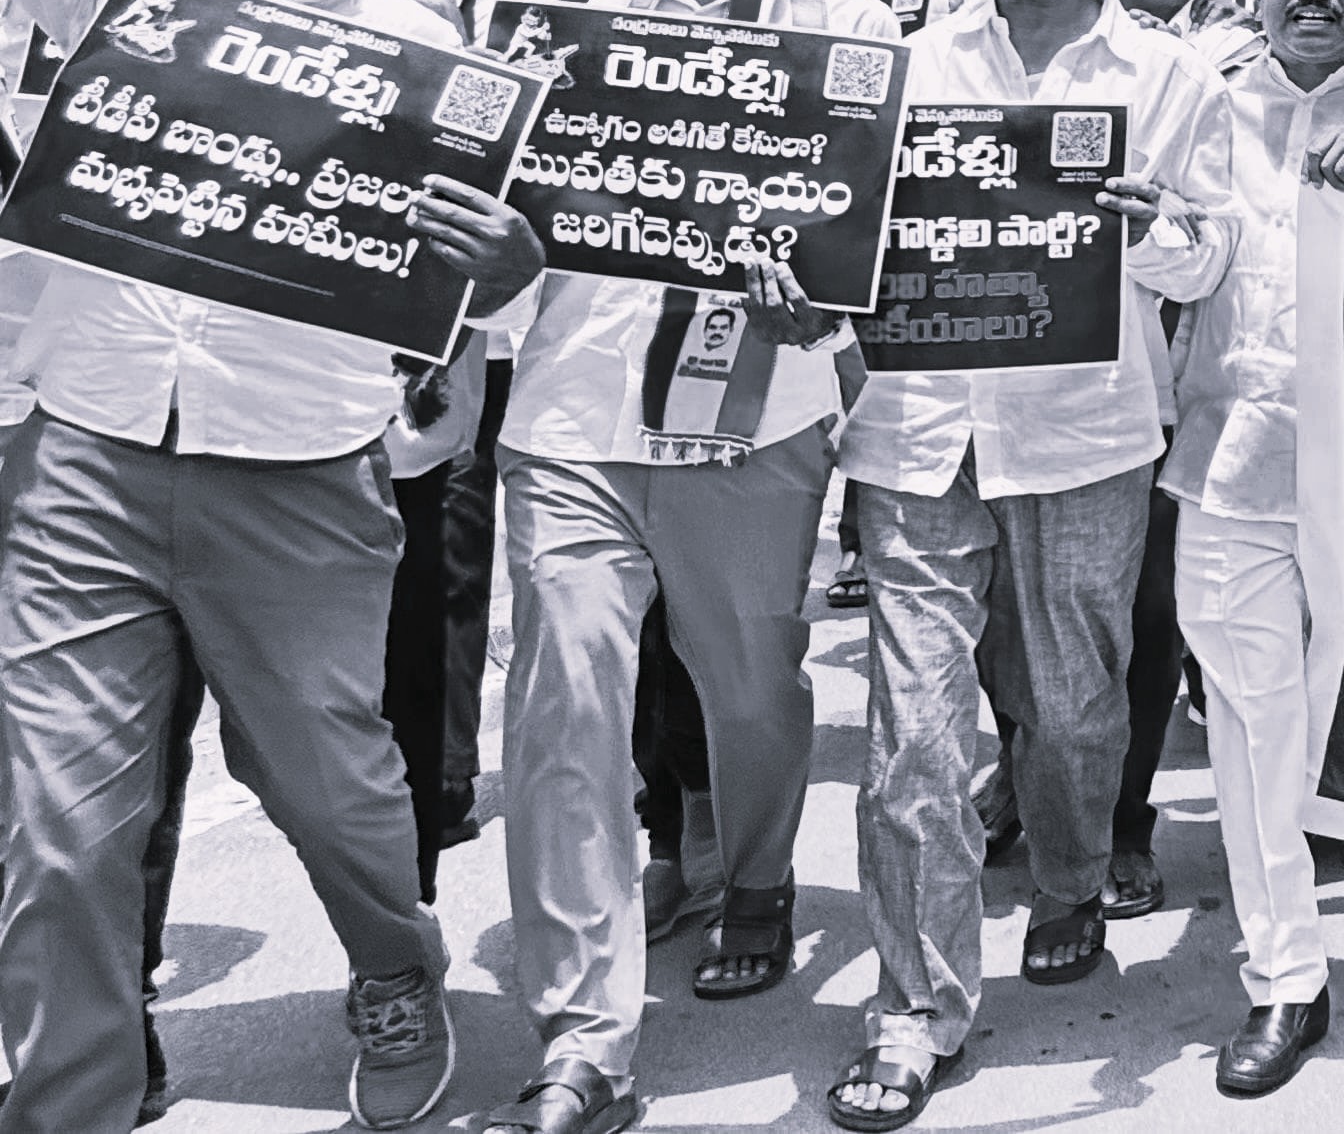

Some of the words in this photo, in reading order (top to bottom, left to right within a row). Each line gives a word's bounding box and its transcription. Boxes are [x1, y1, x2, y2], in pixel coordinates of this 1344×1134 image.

[237, 0, 313, 31] చంద్రబాబు
[312, 20, 402, 56] వెన్నుపోటుకు
[612, 16, 688, 39] చంద్రబాబు
[690, 26, 780, 47] వెన్నుపోటుకు
[207, 25, 400, 132] రెండేళ్లు
[604, 43, 790, 116] రెండేళ్లు
[66, 76, 160, 141] టీడీపీ
[162, 120, 301, 189] బాండ్లు..
[545, 108, 641, 147] ఉద్యోగం
[648, 118, 728, 151] అడిగితే
[732, 123, 828, 164] కేసులా?
[896, 127, 1018, 189] డేళ్లు
[70, 151, 247, 237] మభ్యపెట్టిన
[253, 204, 419, 277] హామీలు!
[695, 169, 852, 223] న్యాయం
[552, 207, 797, 276] జరిగేదెప్పుడు?
[998, 212, 1101, 258] పార్టీ?
